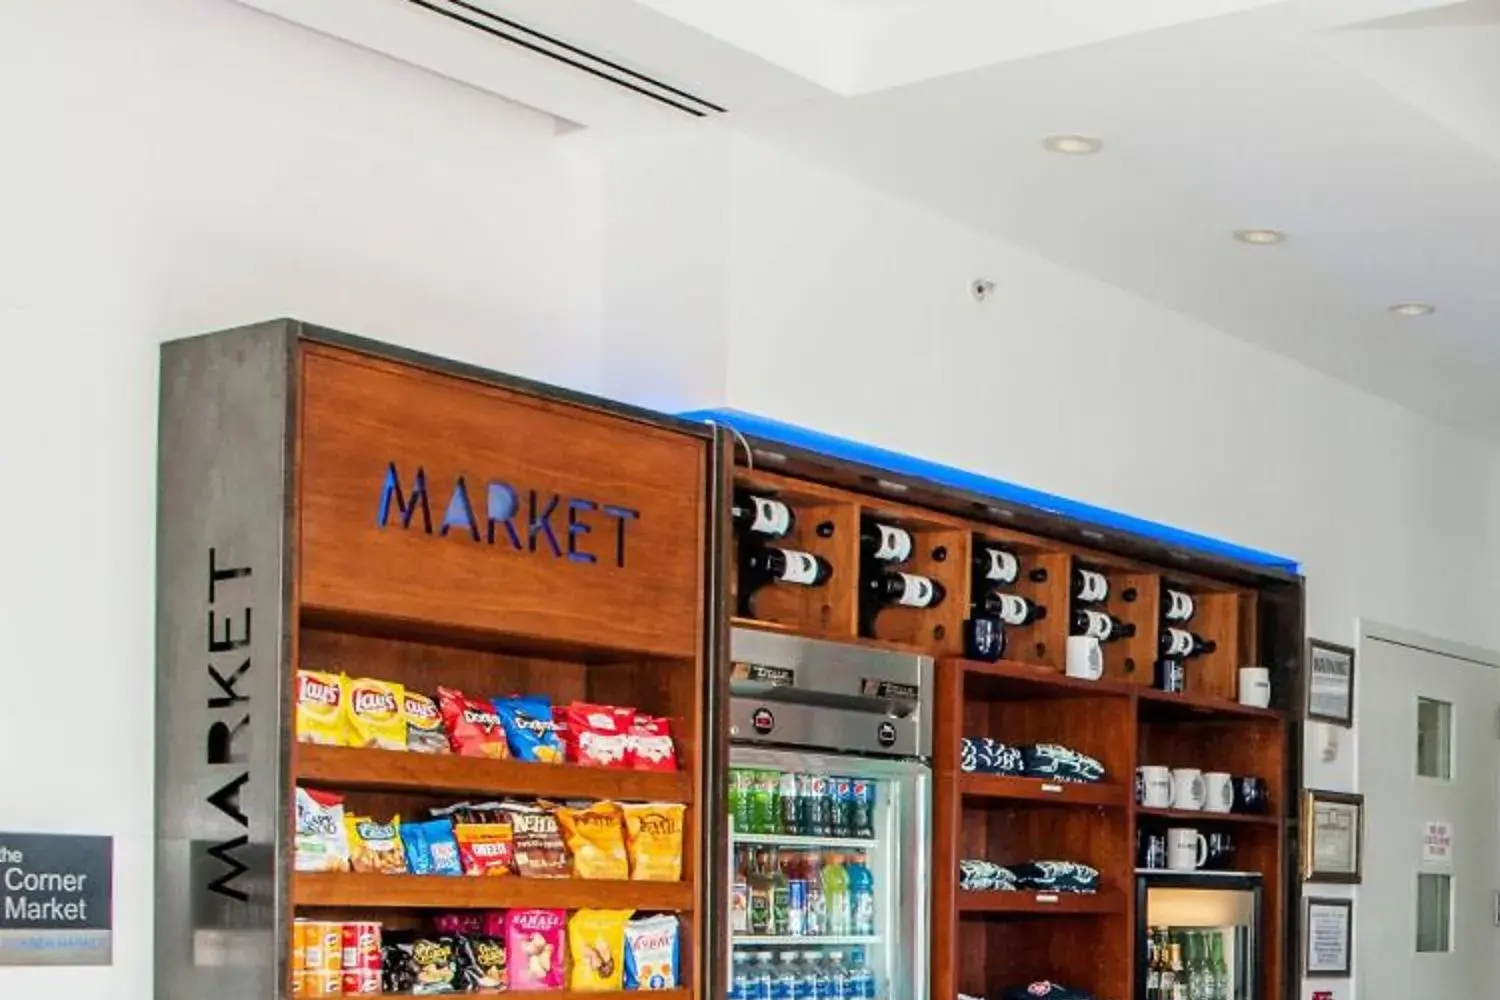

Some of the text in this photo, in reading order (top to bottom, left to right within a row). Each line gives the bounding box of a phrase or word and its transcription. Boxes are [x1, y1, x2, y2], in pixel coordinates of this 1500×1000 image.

[375, 460, 640, 568] MARKET
[354, 689, 395, 714] Lay's
[405, 699, 438, 719] ay's
[206, 547, 253, 903] MARKET
[4, 867, 88, 892] Corner
[4, 895, 88, 921] Market
